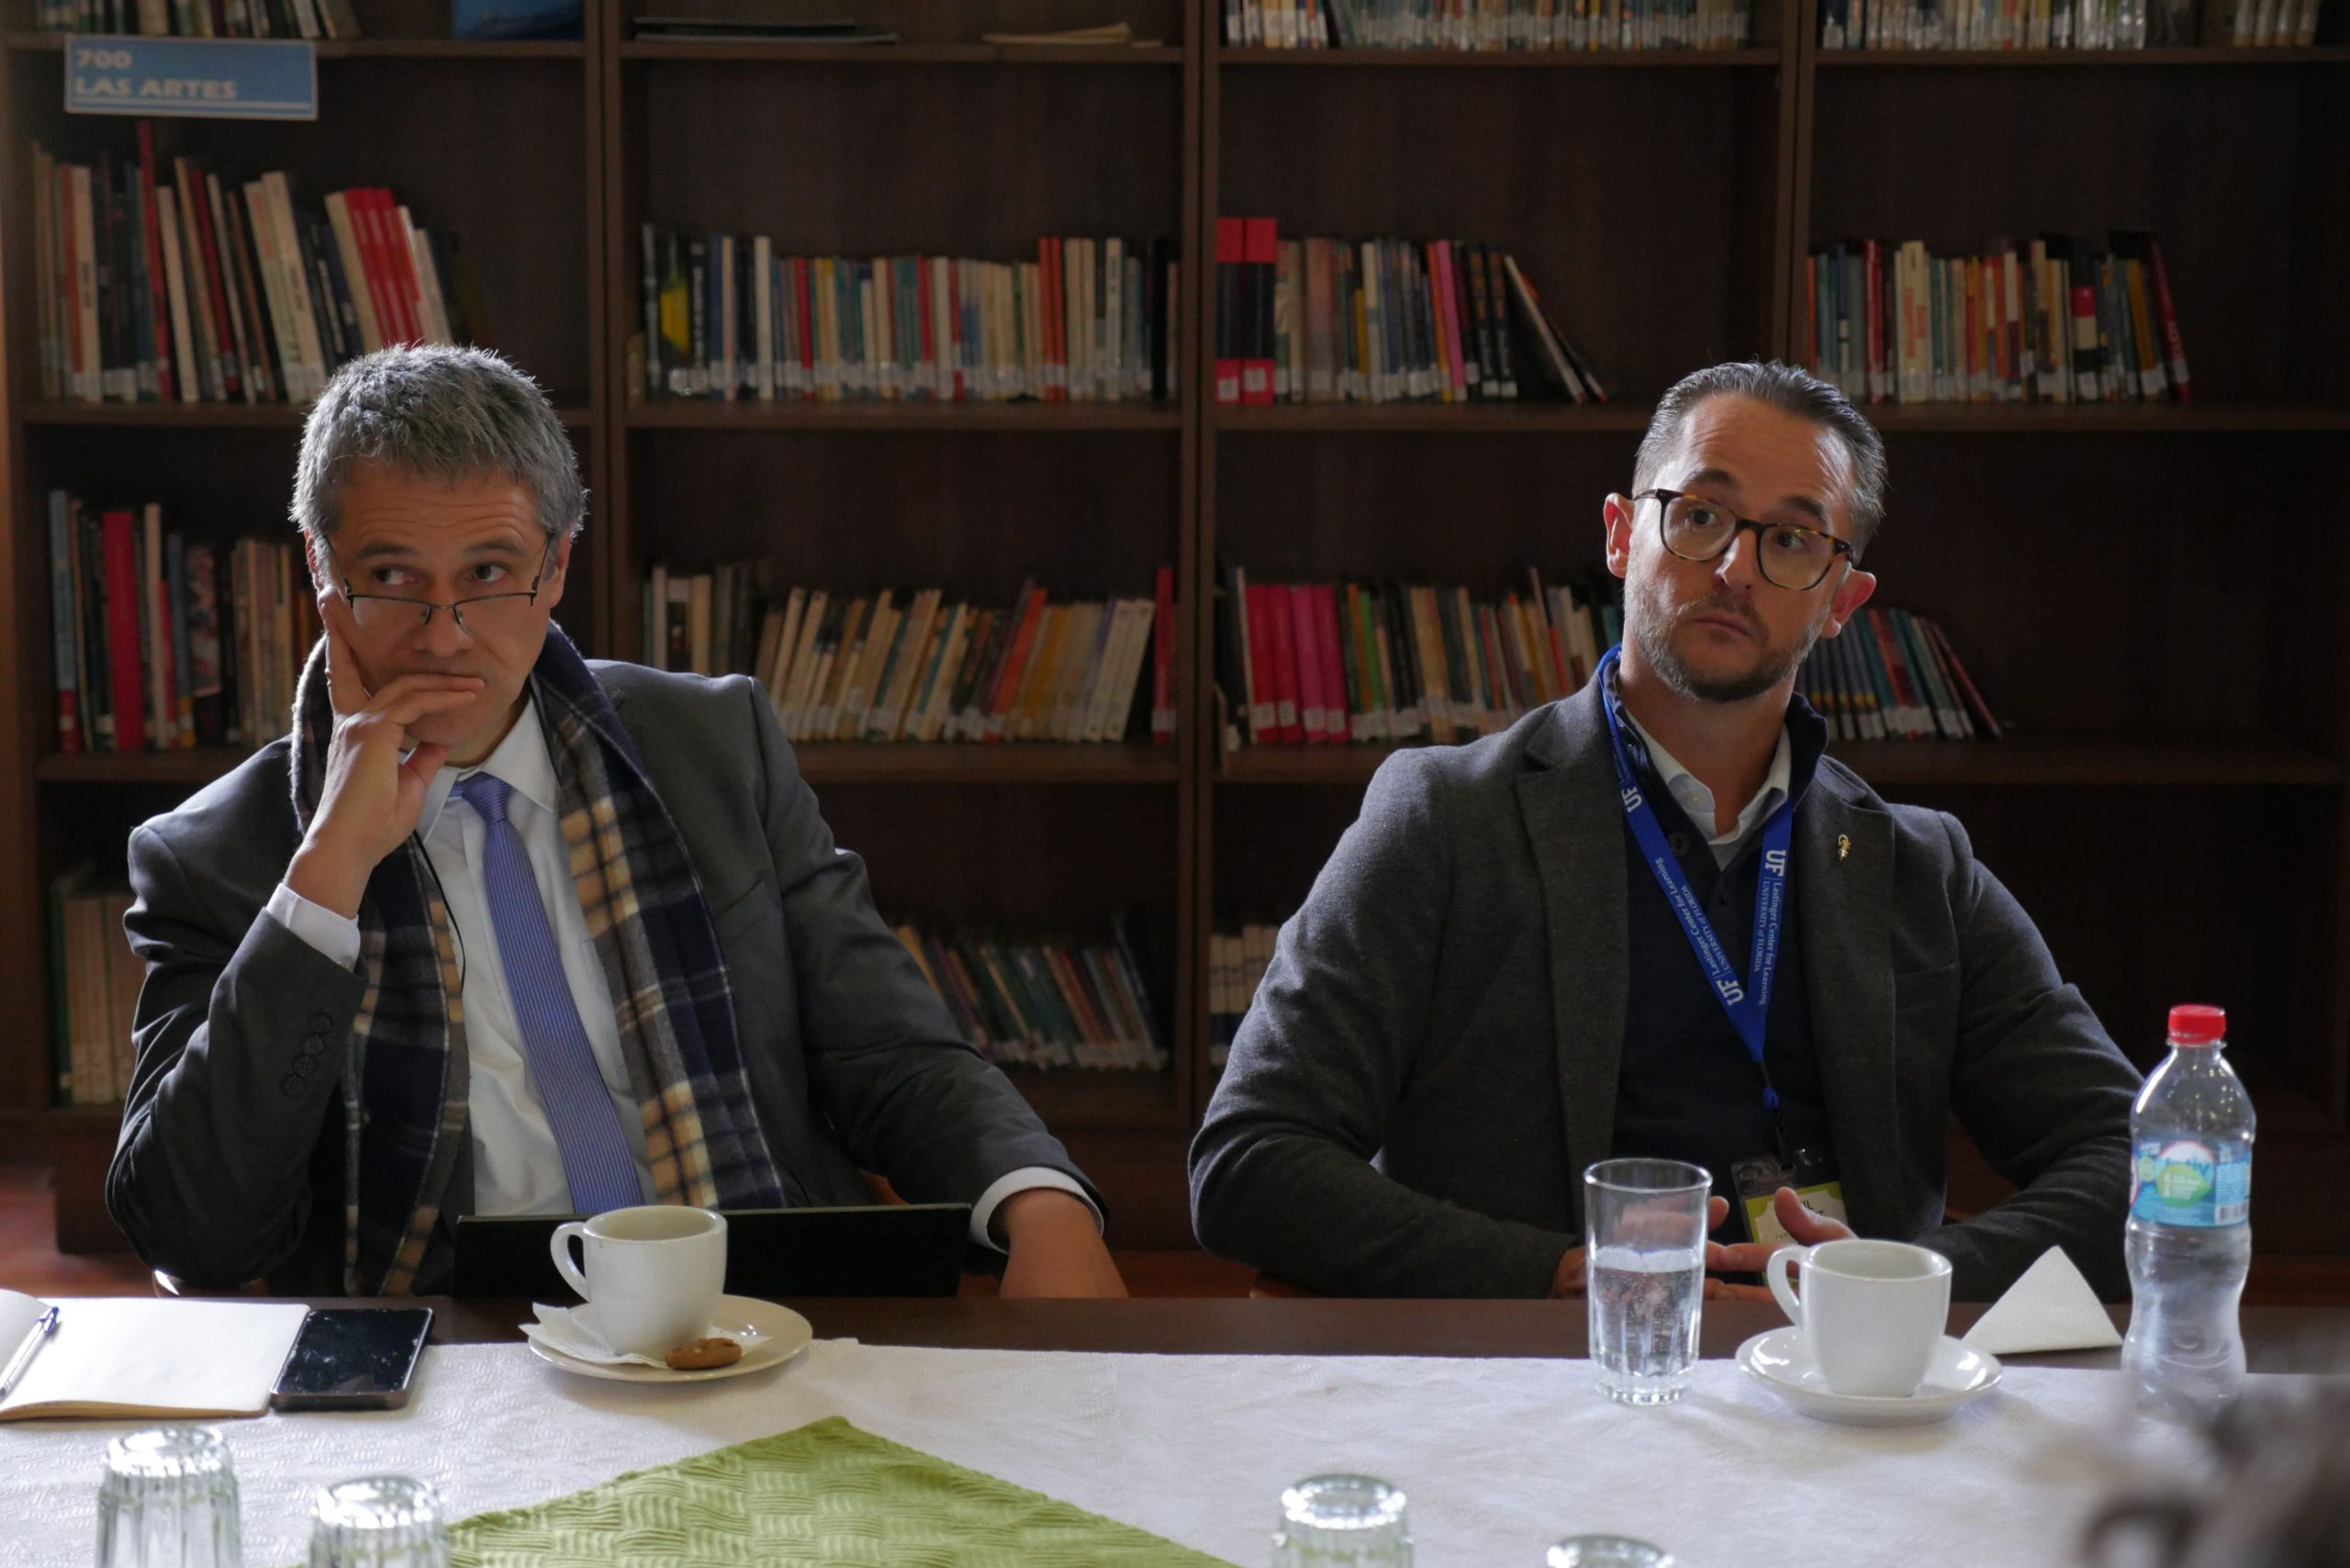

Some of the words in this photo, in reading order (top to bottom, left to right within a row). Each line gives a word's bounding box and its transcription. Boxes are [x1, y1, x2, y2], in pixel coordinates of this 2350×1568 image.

[75, 49, 132, 70] 700
[75, 76, 132, 97] LAS
[140, 79, 237, 100] ARTES
[1621, 786, 1642, 813] UF
[1654, 857, 1678, 895] Learning
[1764, 849, 1786, 877] UF
[1674, 894, 1686, 907] for
[1681, 884, 1701, 917] FLORIDA
[1759, 881, 1770, 929] UNIVERSITY
[1768, 882, 1782, 921] Lastinger
[1682, 907, 1700, 936] Center
[1702, 925, 1730, 971] UNIVERSITY
[1766, 923, 1778, 951] Center
[1697, 936, 1720, 977] Lastinger
[1753, 938, 1764, 973] FLORIDA
[1765, 952, 1775, 966] for
[1716, 979, 1745, 1007] UF
[1759, 967, 1773, 1006] Learning
